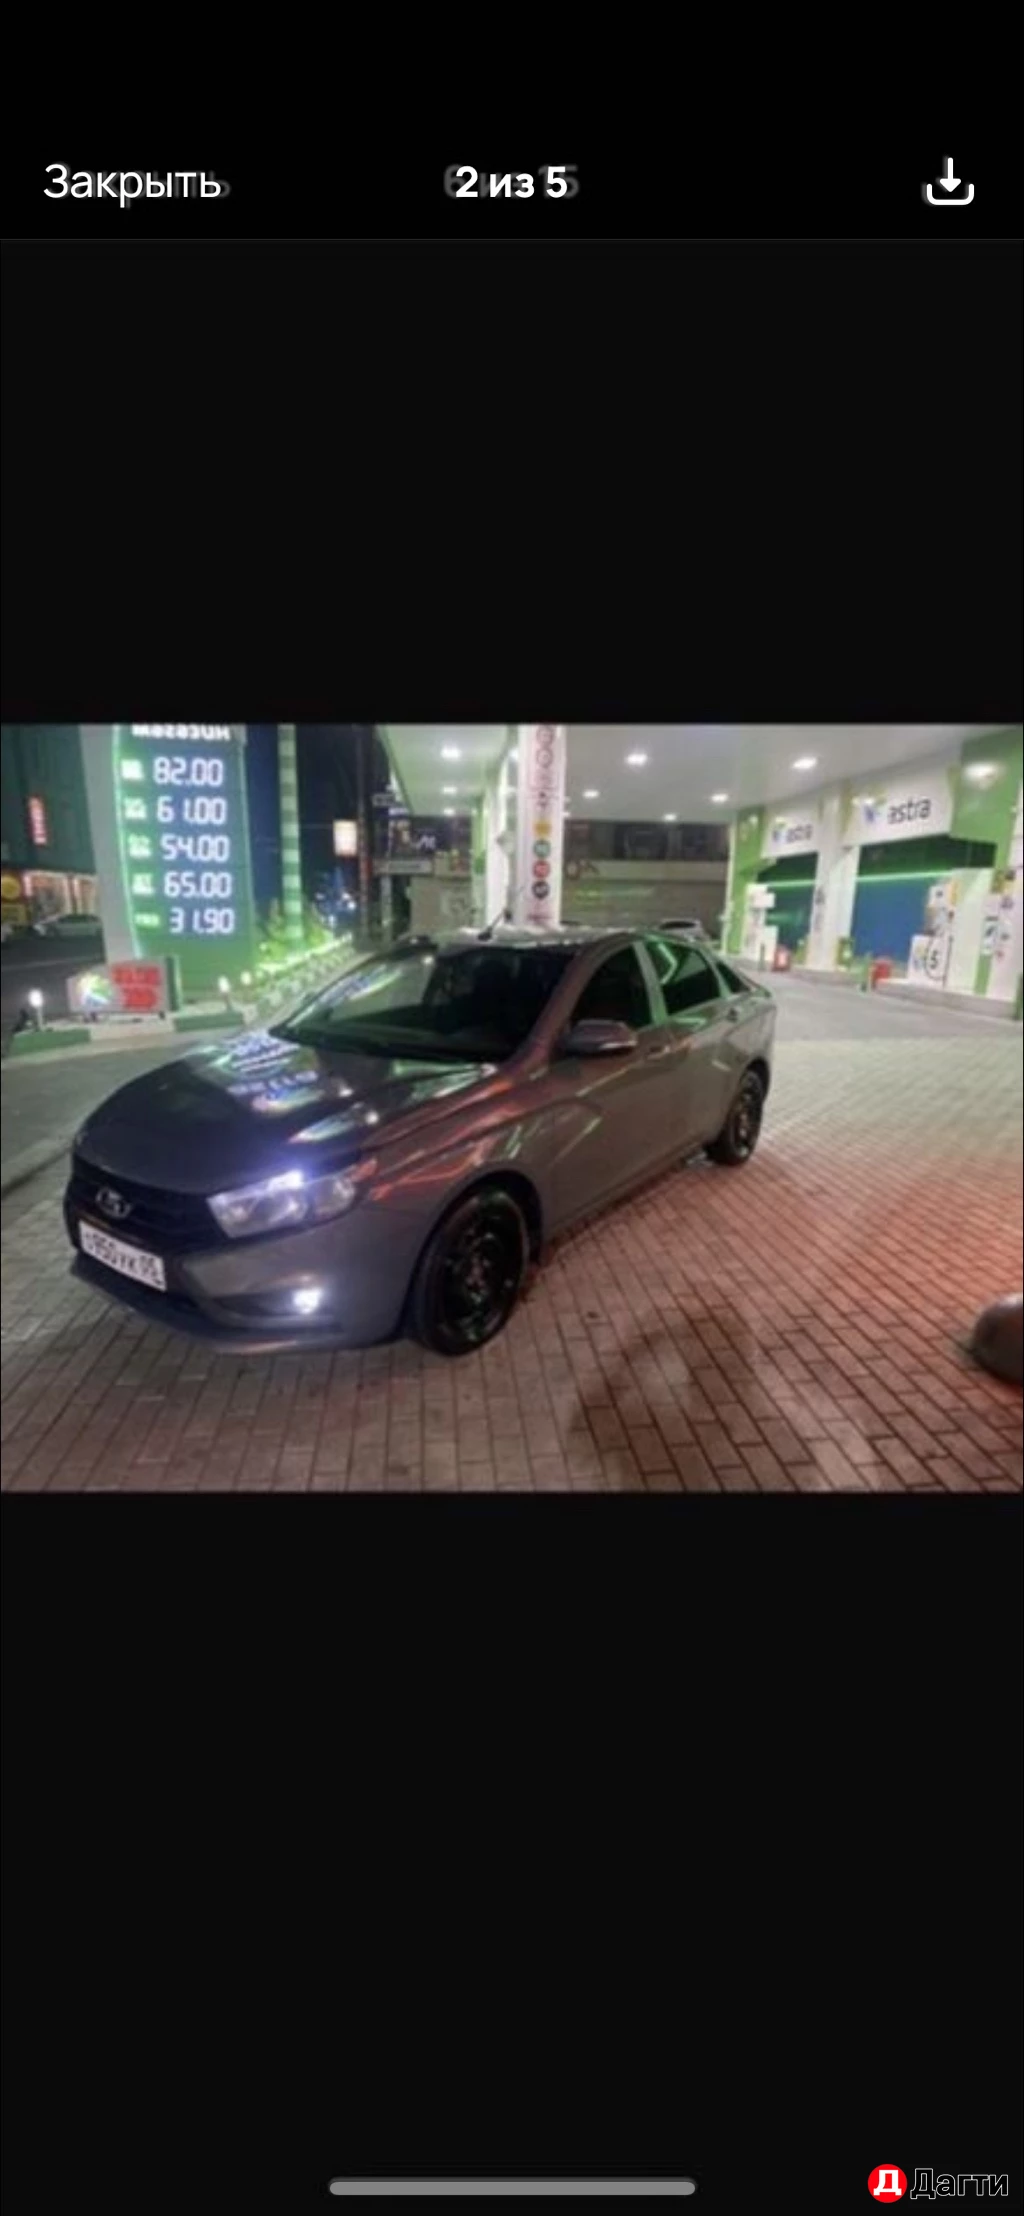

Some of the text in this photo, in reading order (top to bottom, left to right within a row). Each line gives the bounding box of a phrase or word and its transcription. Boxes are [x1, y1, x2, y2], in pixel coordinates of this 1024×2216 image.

[154, 756, 223, 787] 82.00
[157, 795, 227, 825] 61.00
[887, 797, 932, 825] astra
[161, 832, 230, 862] 54.00
[164, 870, 233, 899] 65.00
[170, 906, 236, 934] 31.90
